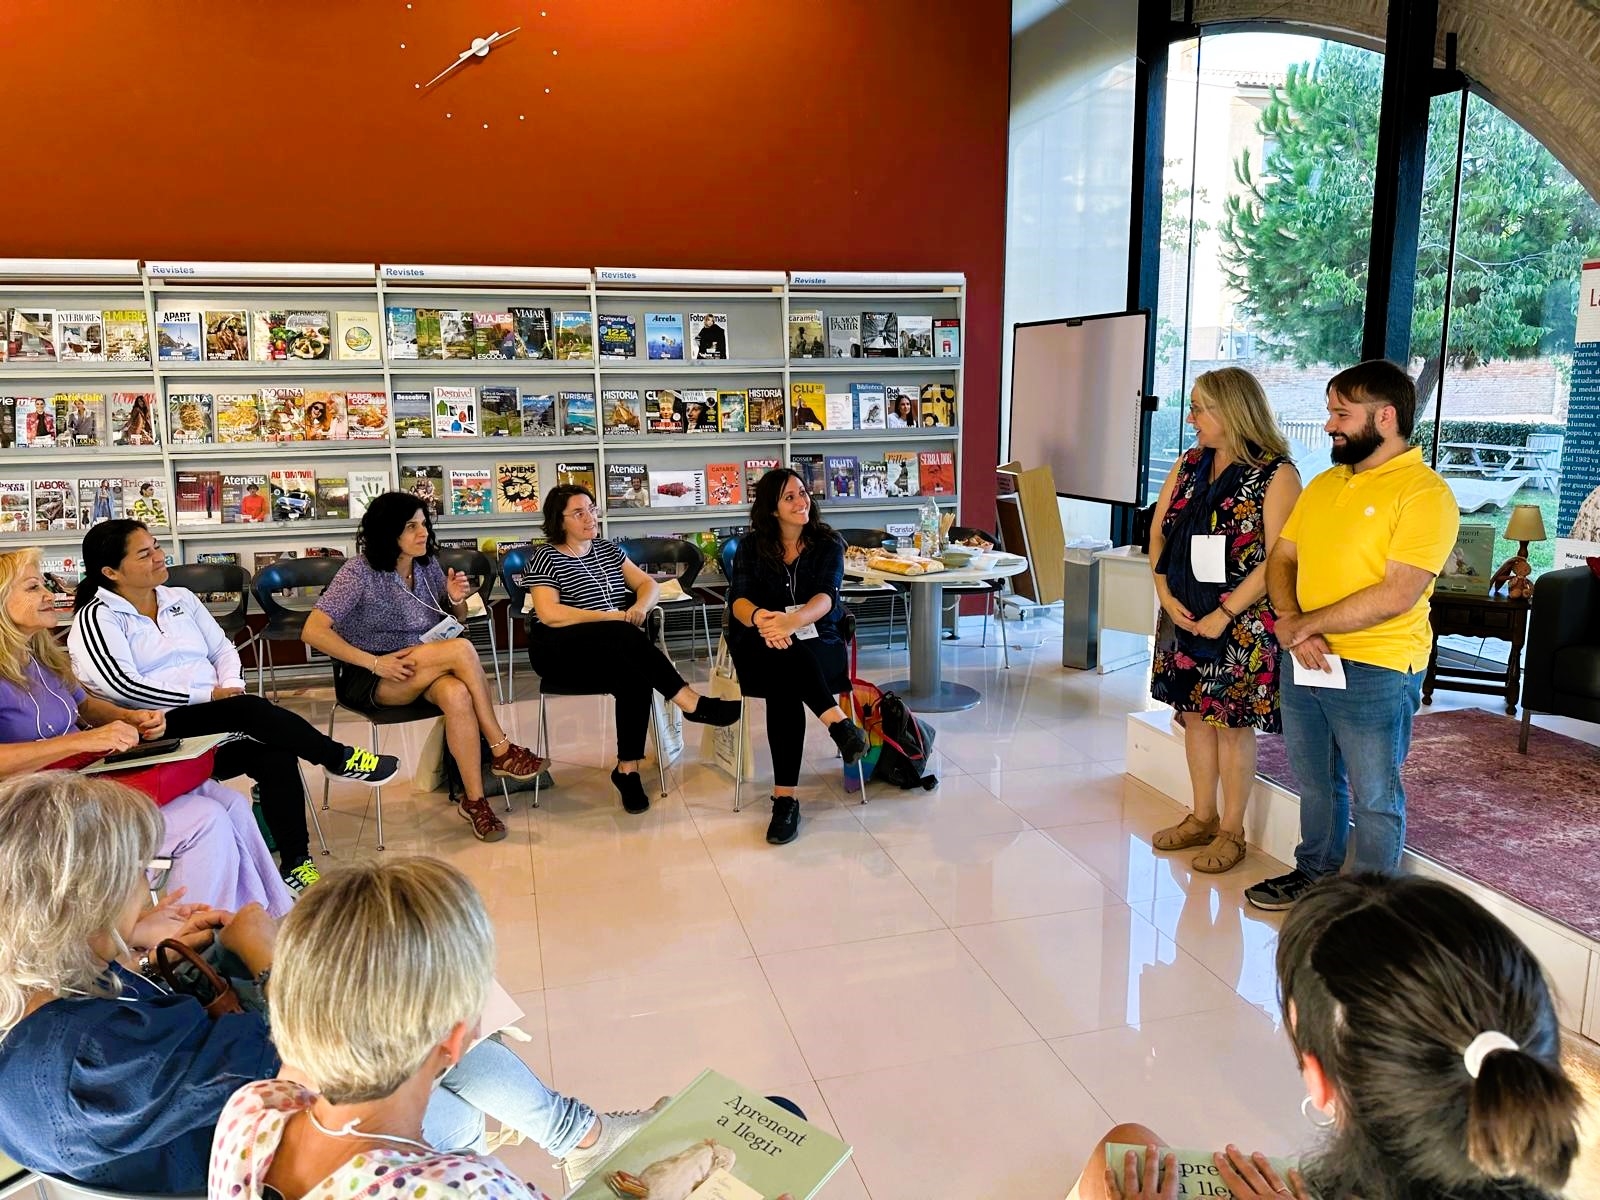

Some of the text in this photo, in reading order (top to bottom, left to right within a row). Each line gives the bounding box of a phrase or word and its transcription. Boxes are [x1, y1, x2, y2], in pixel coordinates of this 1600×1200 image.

[152, 265, 195, 274] Revistes
[386, 268, 424, 276] Revistes
[601, 271, 636, 279] Revistes
[515, 309, 545, 318] VIAJAR
[58, 314, 100, 323] INTERIORES
[476, 314, 512, 324] VIAJES
[652, 315, 676, 323] Arrels
[607, 328, 627, 336] 122
[437, 388, 472, 398] Desnivel
[748, 389, 782, 398] HISTORIA
[793, 385, 815, 394] CLIJ
[171, 395, 209, 403] CUINA
[603, 391, 638, 400] HISTORIA
[920, 453, 941, 465] SERRA
[558, 463, 587, 472] Quercus
[746, 460, 778, 468] muy
[609, 464, 645, 474] Ateneus
[452, 470, 488, 478] Perspectiva
[223, 475, 265, 485] Ateneus
[724, 1095, 808, 1147] Aprenent
[716, 1113, 783, 1157] a llegir
